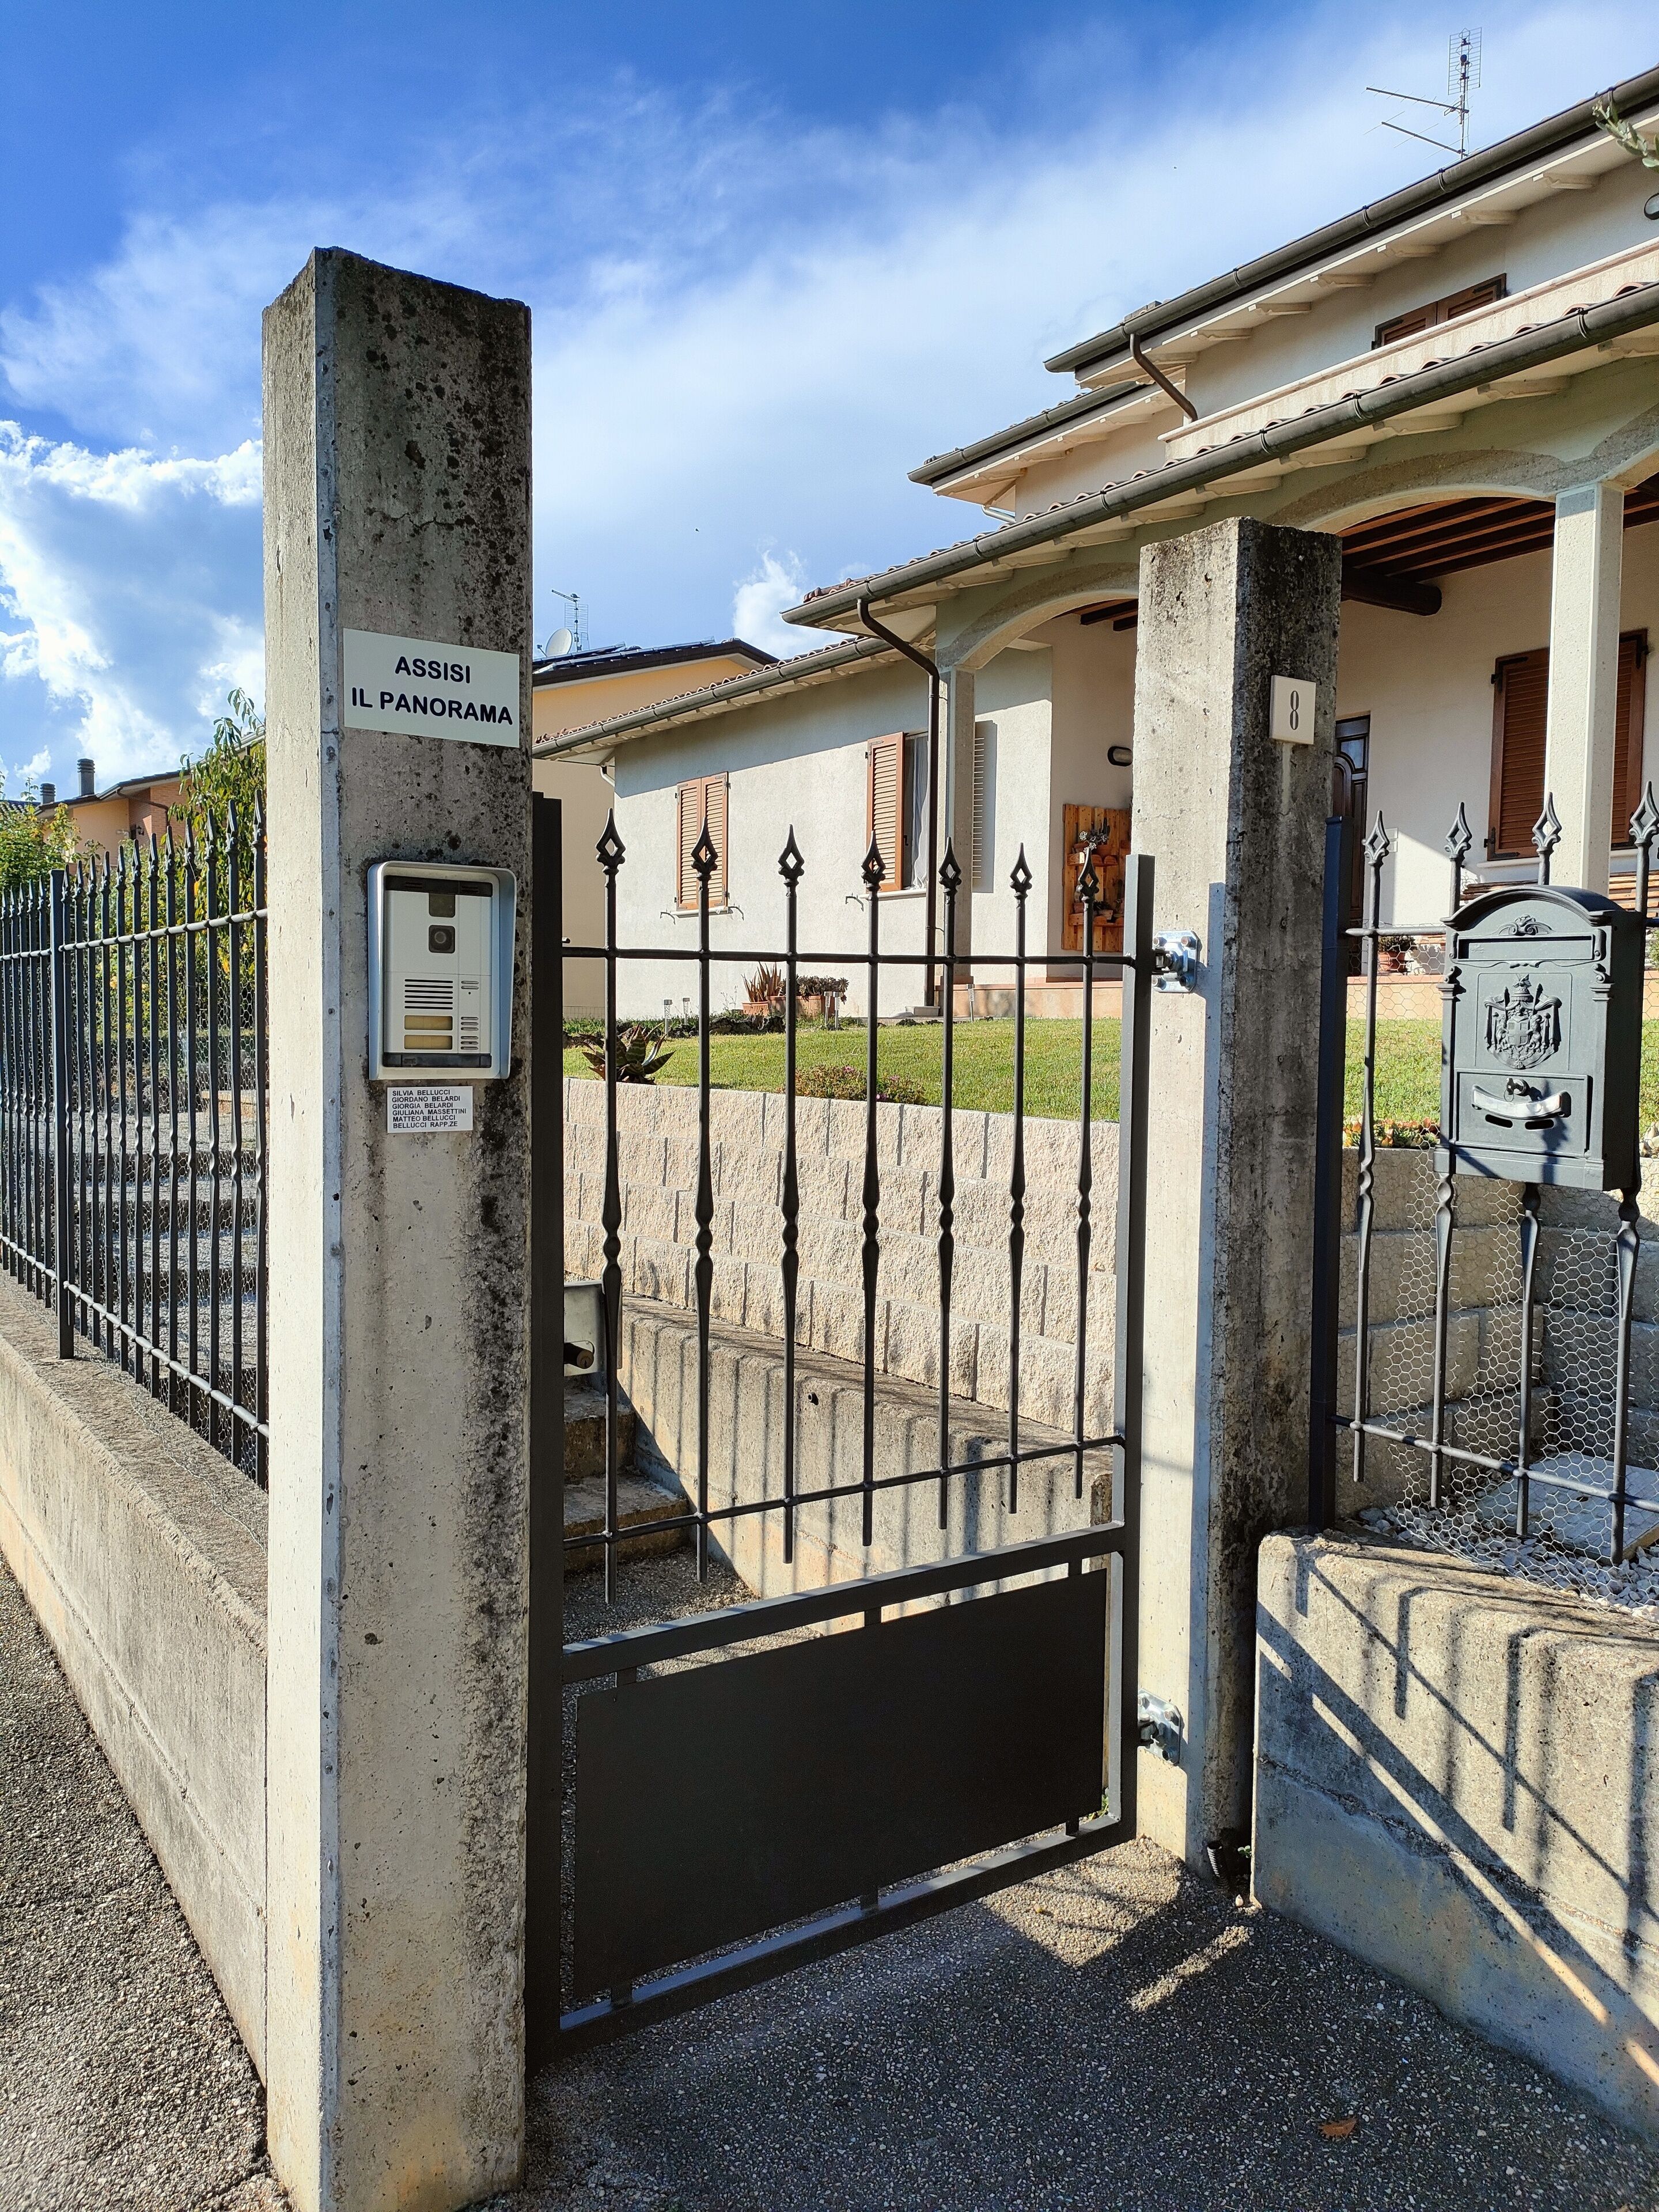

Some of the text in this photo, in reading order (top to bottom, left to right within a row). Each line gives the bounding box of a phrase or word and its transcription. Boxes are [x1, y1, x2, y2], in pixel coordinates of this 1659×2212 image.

[395, 656, 470, 683] ASSISI
[352, 687, 513, 725] IL PANORAMA
[1290, 691, 1299, 730] 8
